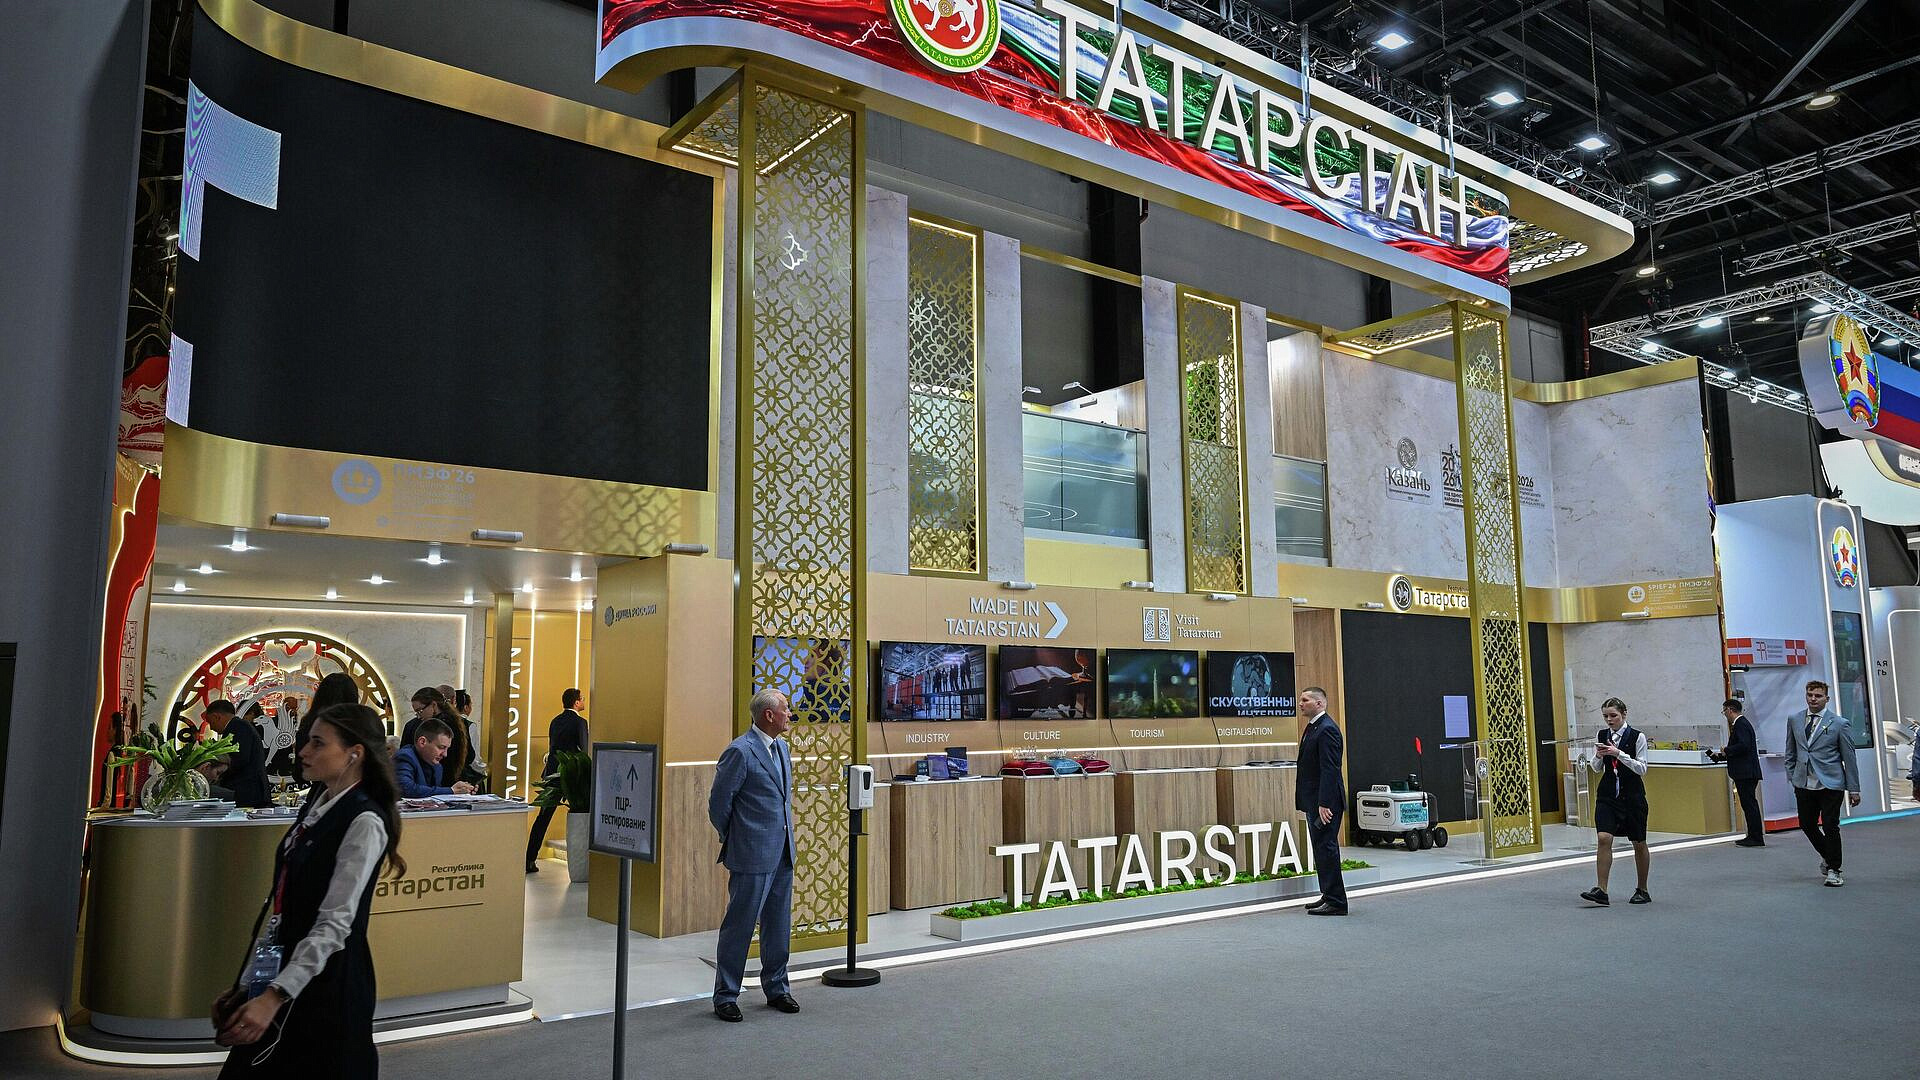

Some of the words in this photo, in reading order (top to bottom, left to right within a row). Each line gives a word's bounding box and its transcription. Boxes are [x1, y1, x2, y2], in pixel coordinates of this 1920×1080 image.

[919, 37, 974, 66] ТАТАРСТАН
[1037, 0, 1469, 247] ТАТАРСТАН
[1387, 467, 1431, 492] Казань
[969, 597, 1019, 616] MADE
[1022, 600, 1040, 617] IN
[1416, 587, 1469, 610] Татарста
[944, 618, 1040, 639] TATARSTAN
[1175, 614, 1200, 626] Visit
[1176, 626, 1222, 639] Tatarstan
[904, 732, 950, 744] INDUSTRY
[1023, 731, 1062, 741] CULTURE
[1129, 729, 1165, 738] TOURISM
[1216, 727, 1274, 737] DIGITALISATION
[614, 796, 632, 812] ПЦР-
[601, 813, 646, 831] тестирование
[431, 862, 485, 874] Республика
[990, 821, 1317, 909] TATARSTA
[375, 873, 485, 899] атарстан
